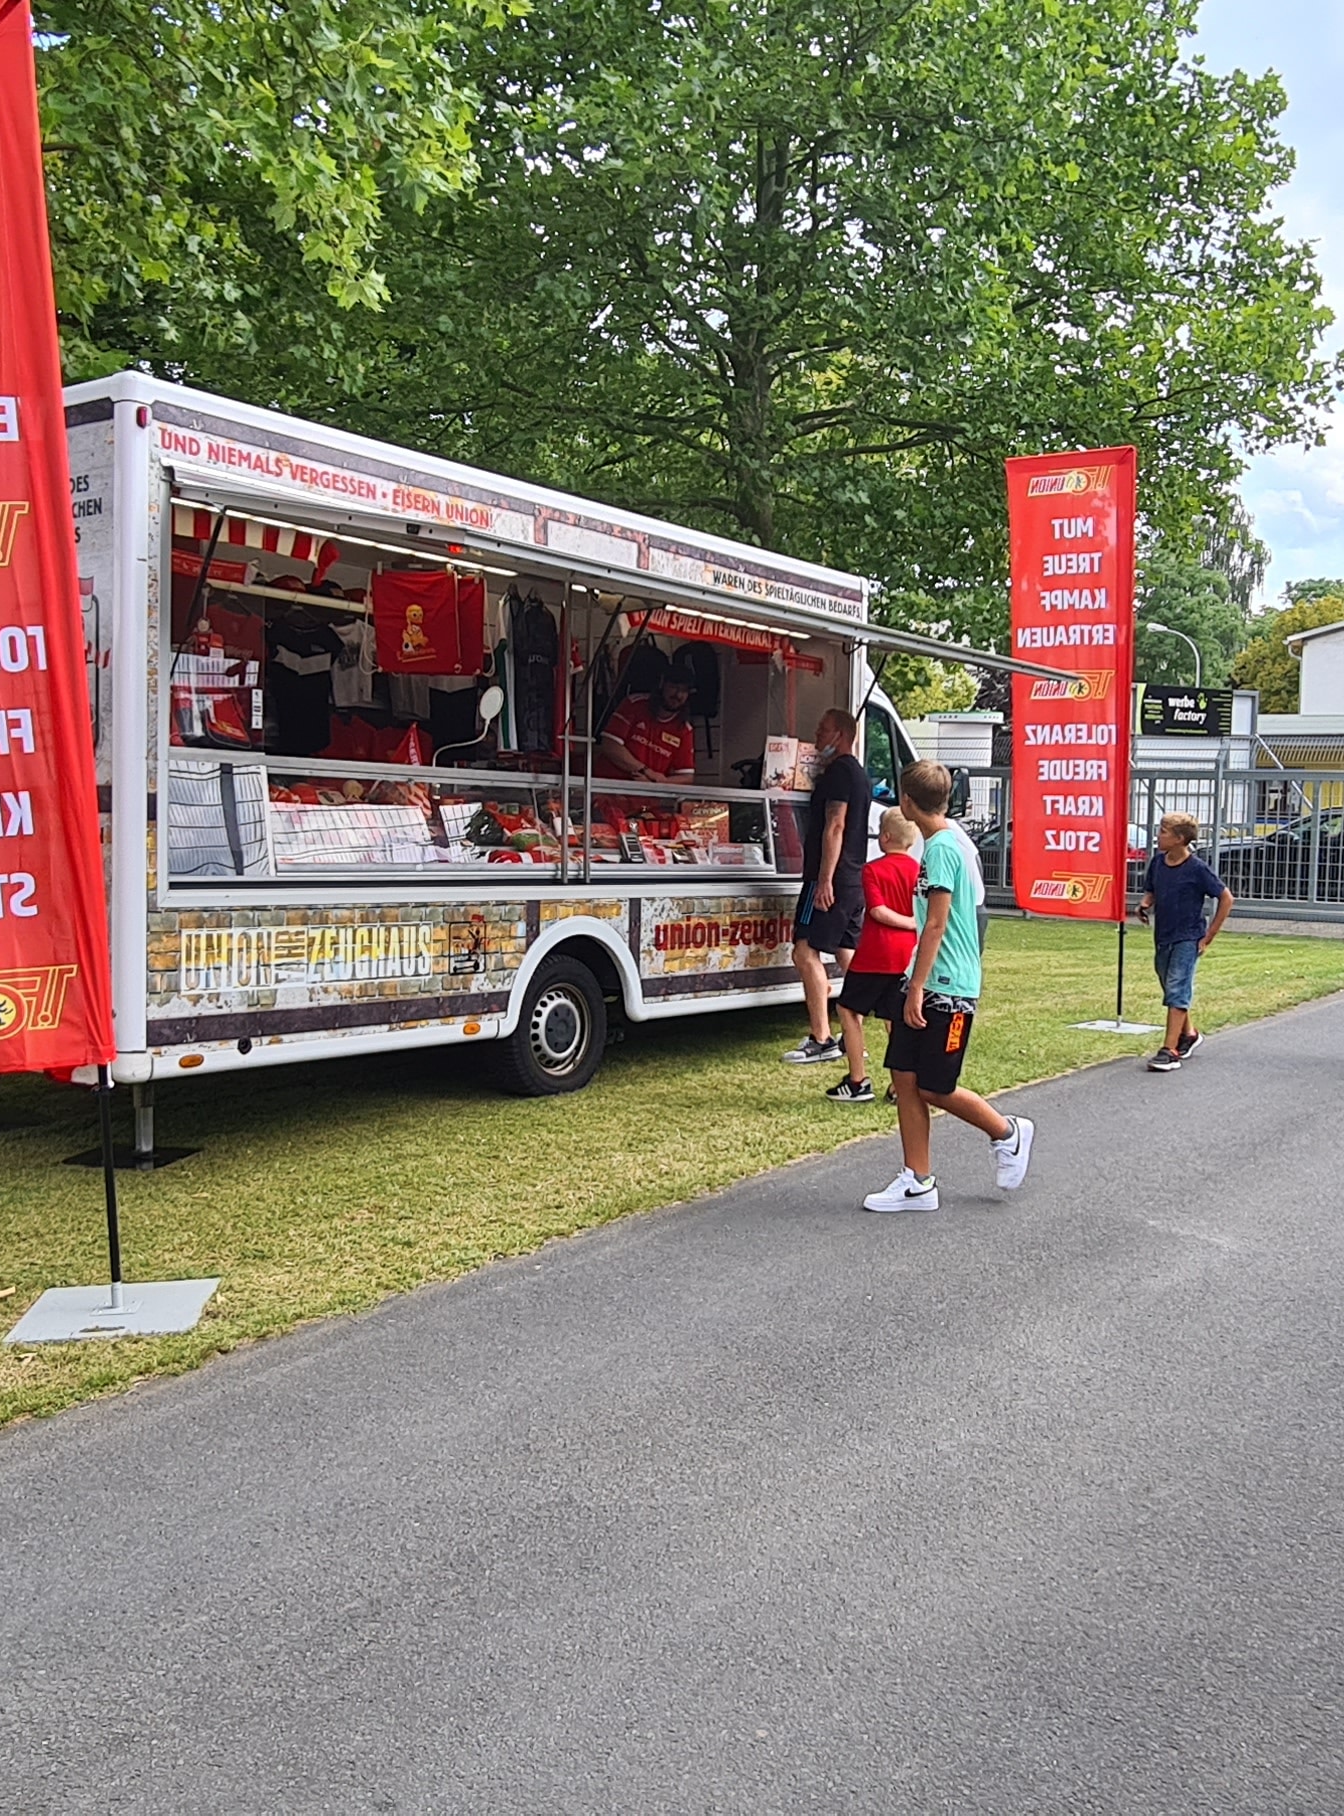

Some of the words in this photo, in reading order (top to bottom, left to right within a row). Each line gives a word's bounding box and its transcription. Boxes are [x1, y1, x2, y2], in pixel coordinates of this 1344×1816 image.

[159, 428, 200, 456] UND
[208, 442, 283, 477] NIEMALS
[289, 462, 376, 500] VERGESSEN
[392, 489, 440, 516] EISERN
[446, 503, 493, 528] UNION!
[713, 570, 745, 590] WAREN
[747, 579, 762, 594] DES
[765, 582, 826, 611] SPIELTÄGLICHEN
[641, 608, 669, 628] UION
[670, 613, 702, 635] SPIELT
[1173, 708, 1207, 725] factory
[654, 912, 794, 951] union-zeugh
[184, 930, 273, 990] UNION
[308, 924, 430, 982] ZEUGHAUS
